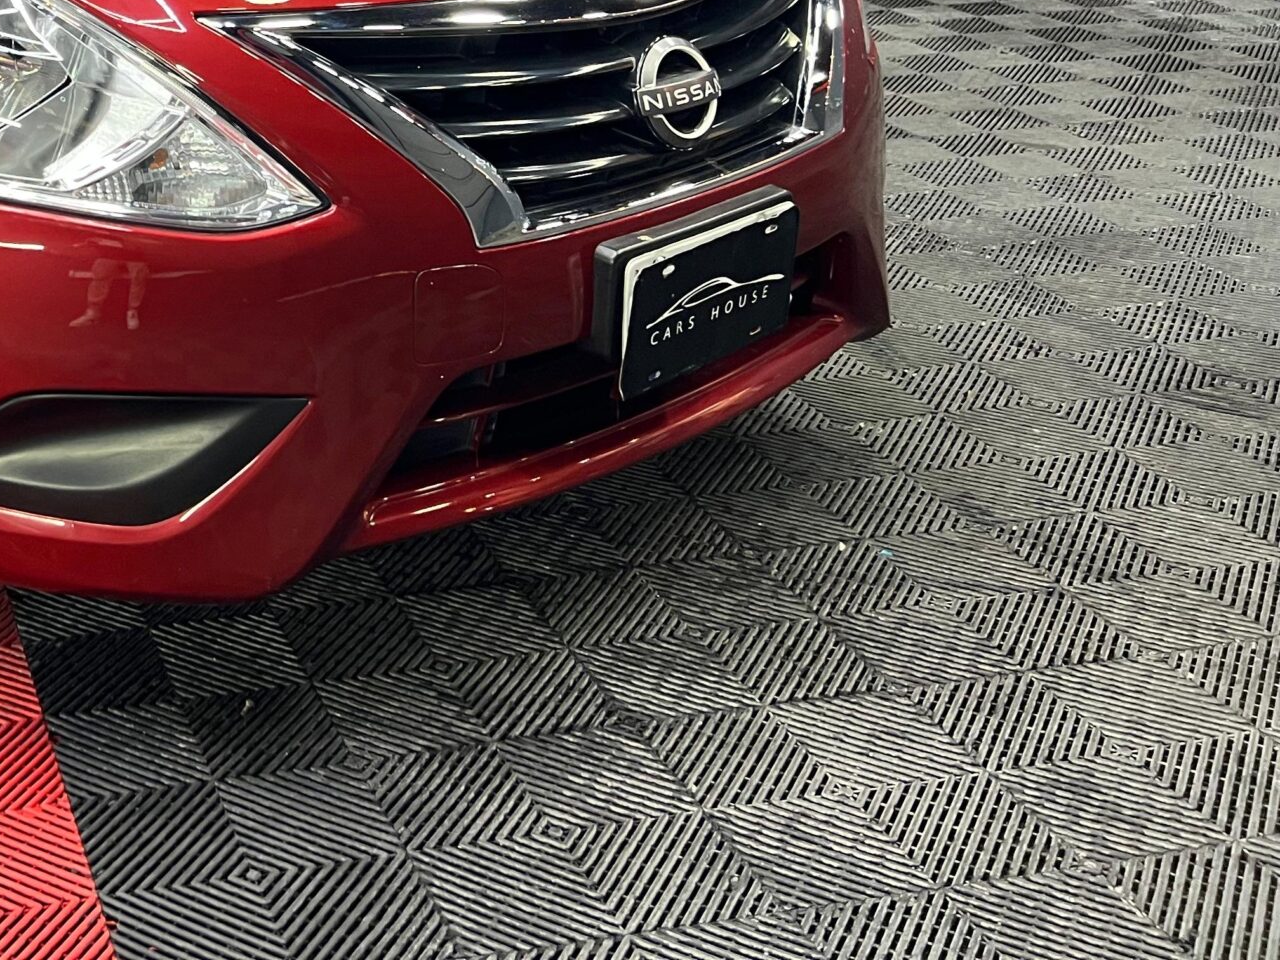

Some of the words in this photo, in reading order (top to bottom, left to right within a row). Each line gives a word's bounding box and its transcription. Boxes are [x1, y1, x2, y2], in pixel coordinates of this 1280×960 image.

[642, 77, 721, 111] NISSAN
[650, 315, 695, 345] CARS
[710, 284, 769, 320] HOUSE
